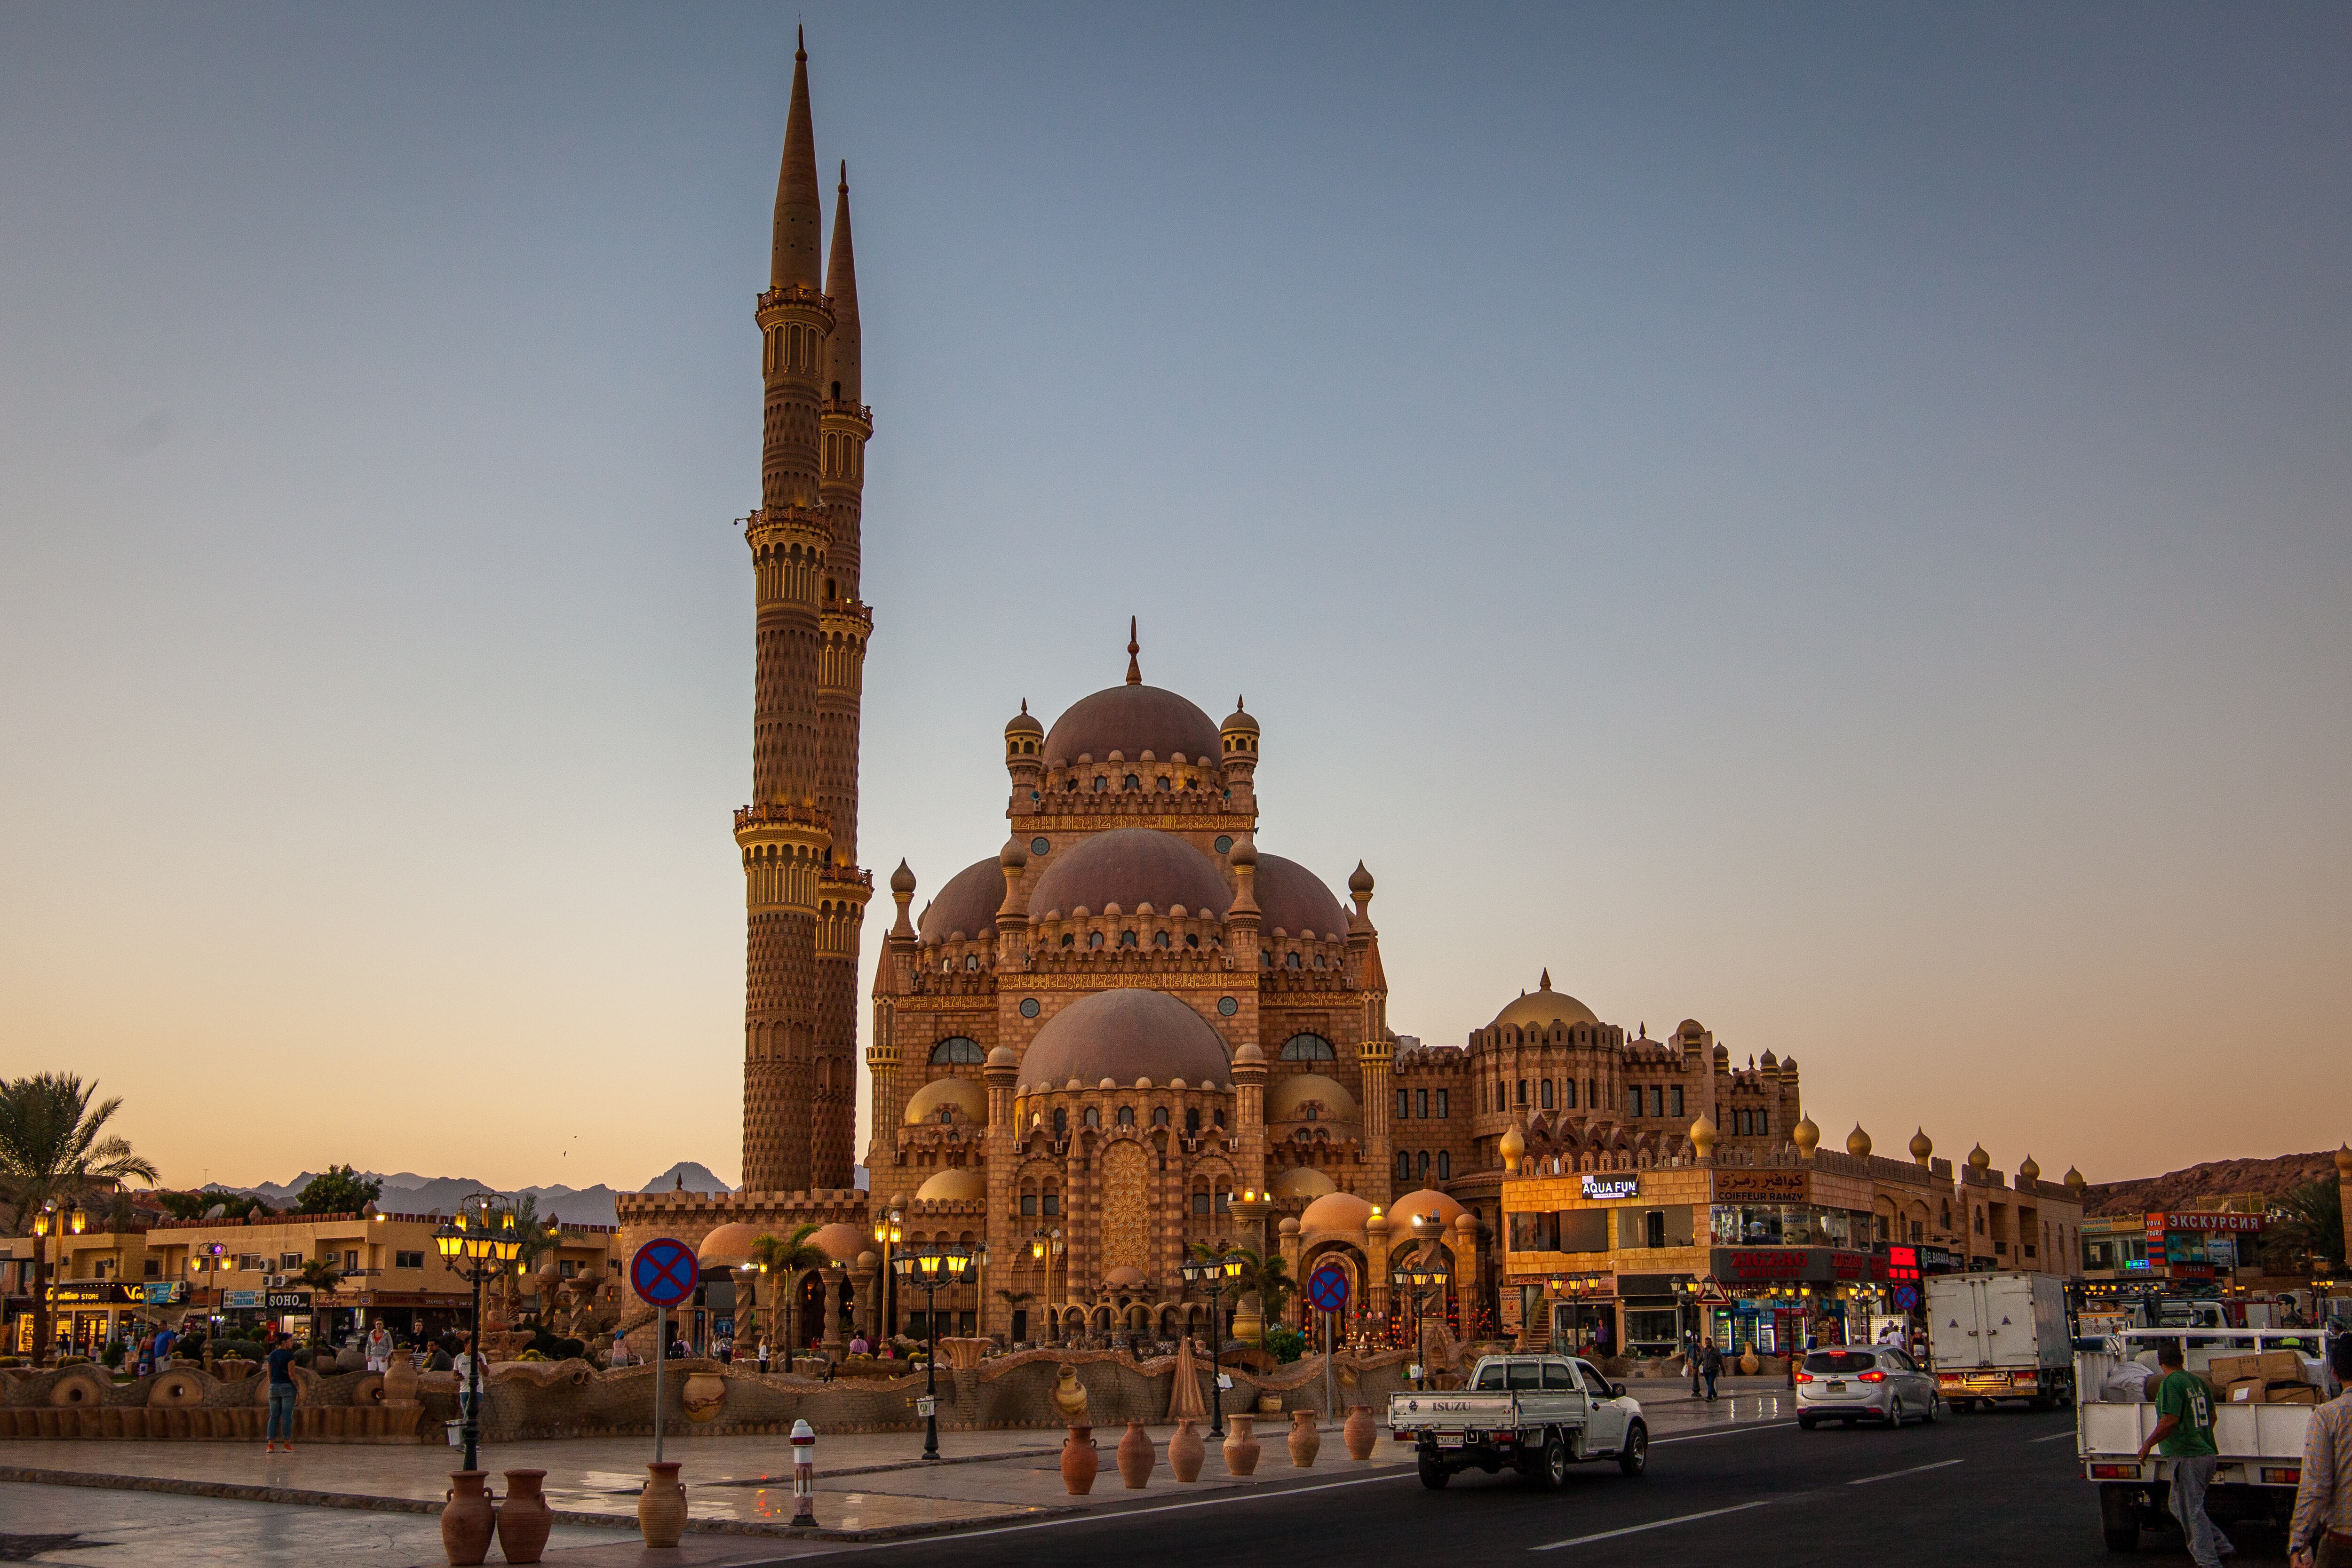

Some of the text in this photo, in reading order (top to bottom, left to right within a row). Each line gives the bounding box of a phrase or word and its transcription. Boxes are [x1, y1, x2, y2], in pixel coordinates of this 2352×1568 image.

[1582, 1181, 1636, 1193] AQUA FUN
[1760, 1173, 1803, 1190] كوافير
[1718, 1192, 1804, 1201] COIFFEUR RAMZY
[2169, 1215, 2258, 1229] ЭКСКУРСИЯ
[1731, 1251, 1809, 1267] ZIGZAG
[1831, 1253, 1865, 1269] ZIGZAG
[269, 1295, 299, 1306] SOHO
[1432, 1402, 1471, 1411] ISUZU
